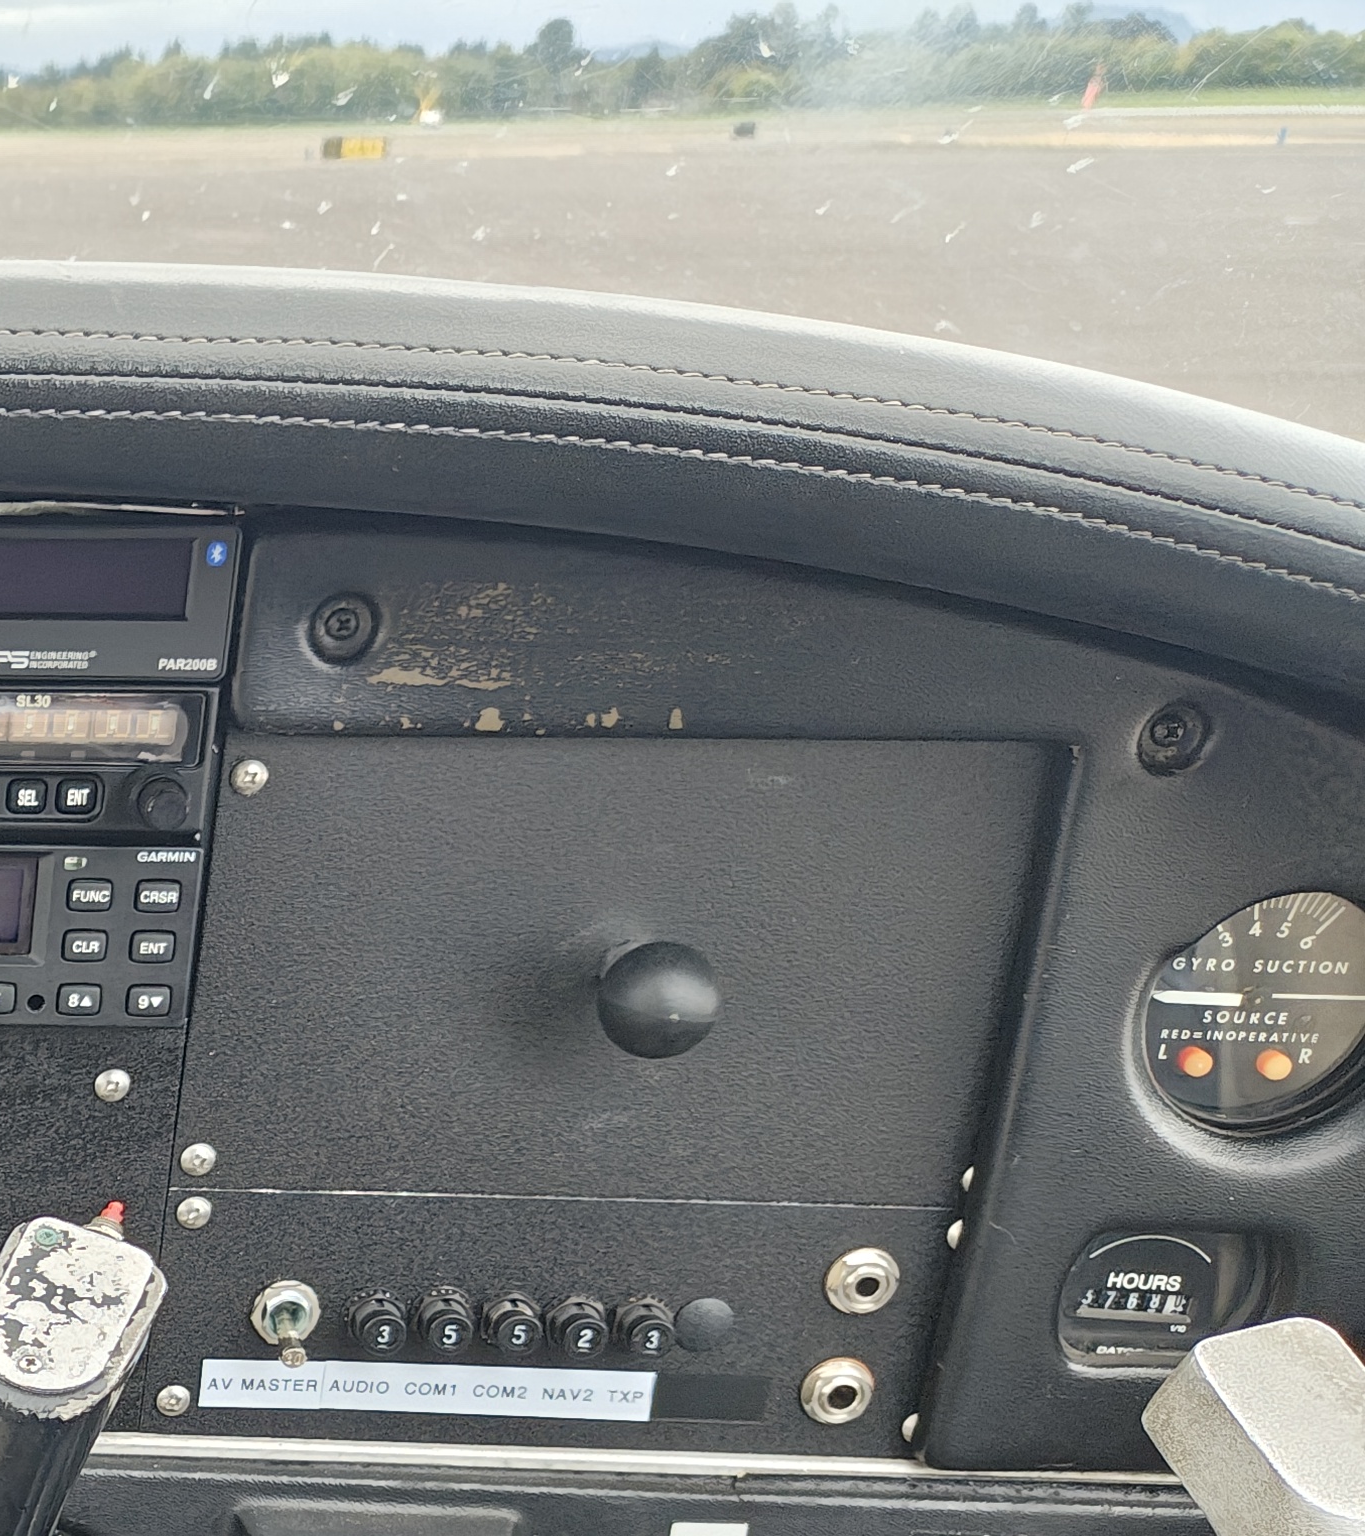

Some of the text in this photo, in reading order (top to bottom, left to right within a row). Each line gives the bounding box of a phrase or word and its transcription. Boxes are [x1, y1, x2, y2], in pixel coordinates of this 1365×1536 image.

[158, 658, 218, 671] PAR200B
[16, 694, 51, 708] SL30
[17, 788, 39, 807] SEL
[66, 788, 91, 806] ENT
[137, 851, 197, 863] GARMIN
[72, 889, 111, 903] FUNC
[139, 890, 179, 904] CRSR
[72, 940, 101, 953] CLR
[1172, 957, 1349, 975] GYRO SUCTION
[1106, 1271, 1182, 1292] HOURS
[207, 1377, 645, 1404] AV MASTER AUDIO COM1 COM2 NAV2 TXP
